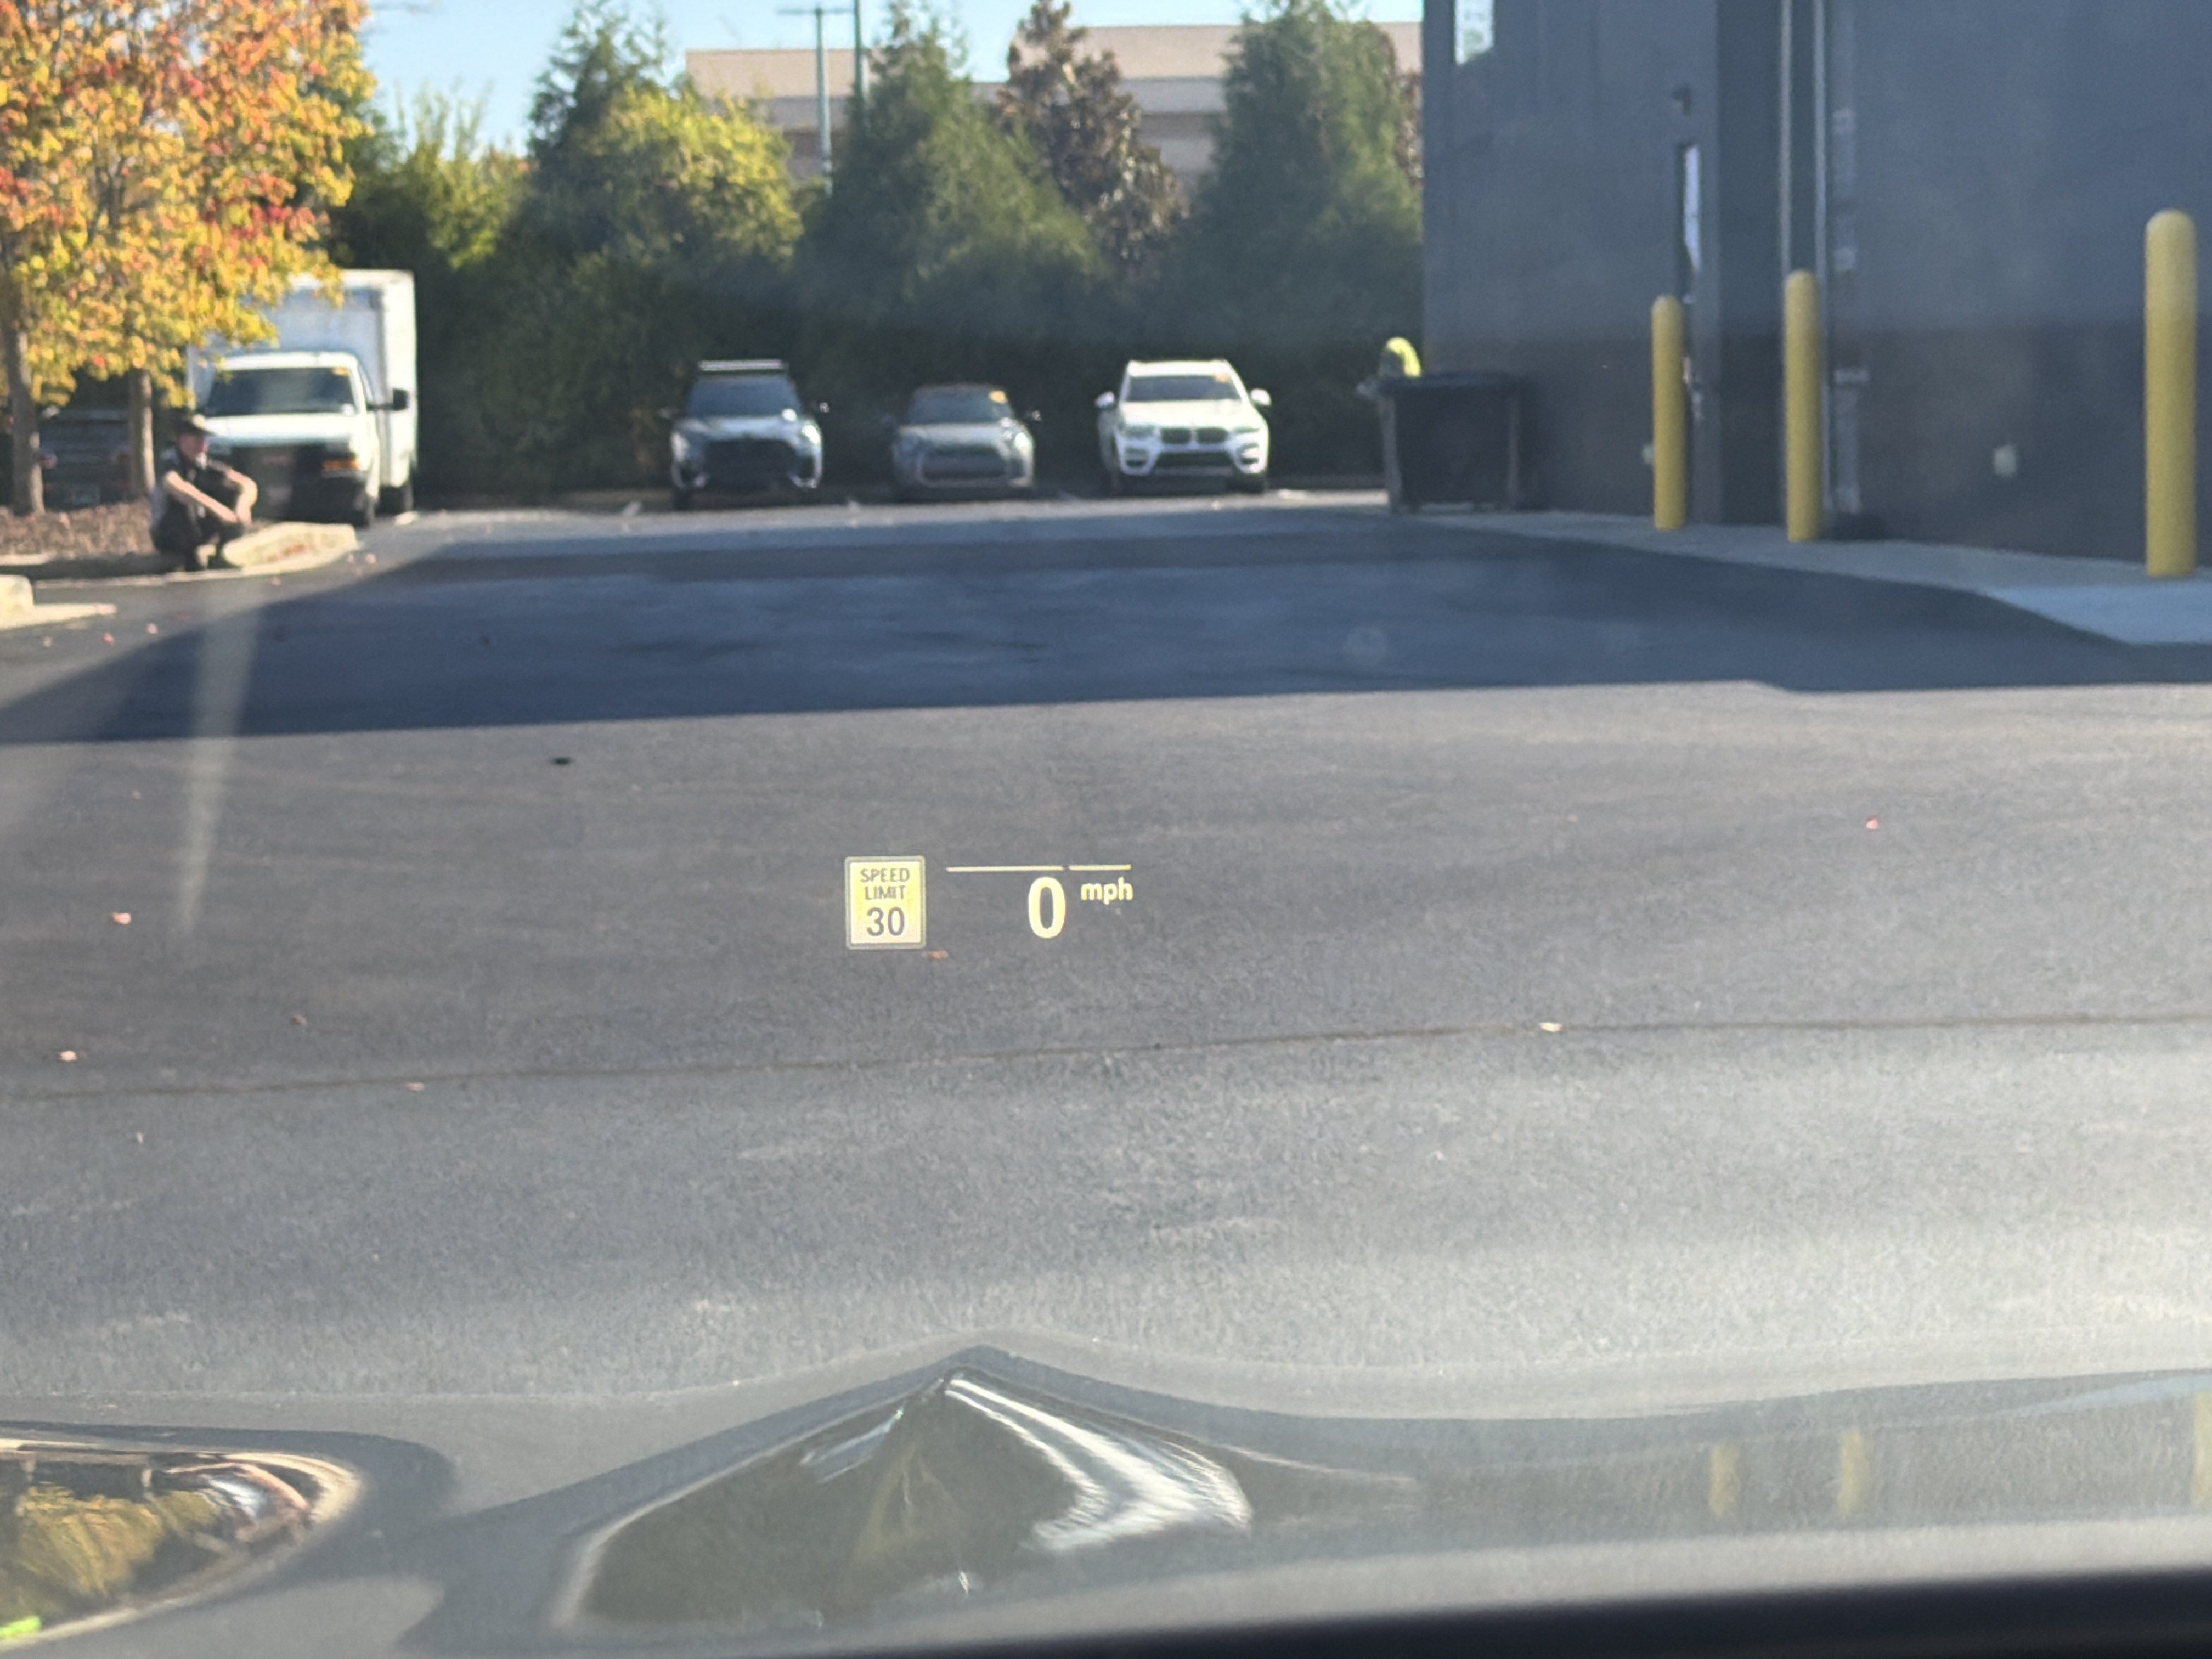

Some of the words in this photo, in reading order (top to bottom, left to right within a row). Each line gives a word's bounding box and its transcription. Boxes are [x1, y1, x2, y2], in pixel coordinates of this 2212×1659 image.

[860, 867, 910, 883] SPEED
[864, 885, 906, 900] LIMIT
[1028, 876, 1066, 939] 0
[1080, 877, 1133, 904] mph
[866, 906, 905, 936] 30
